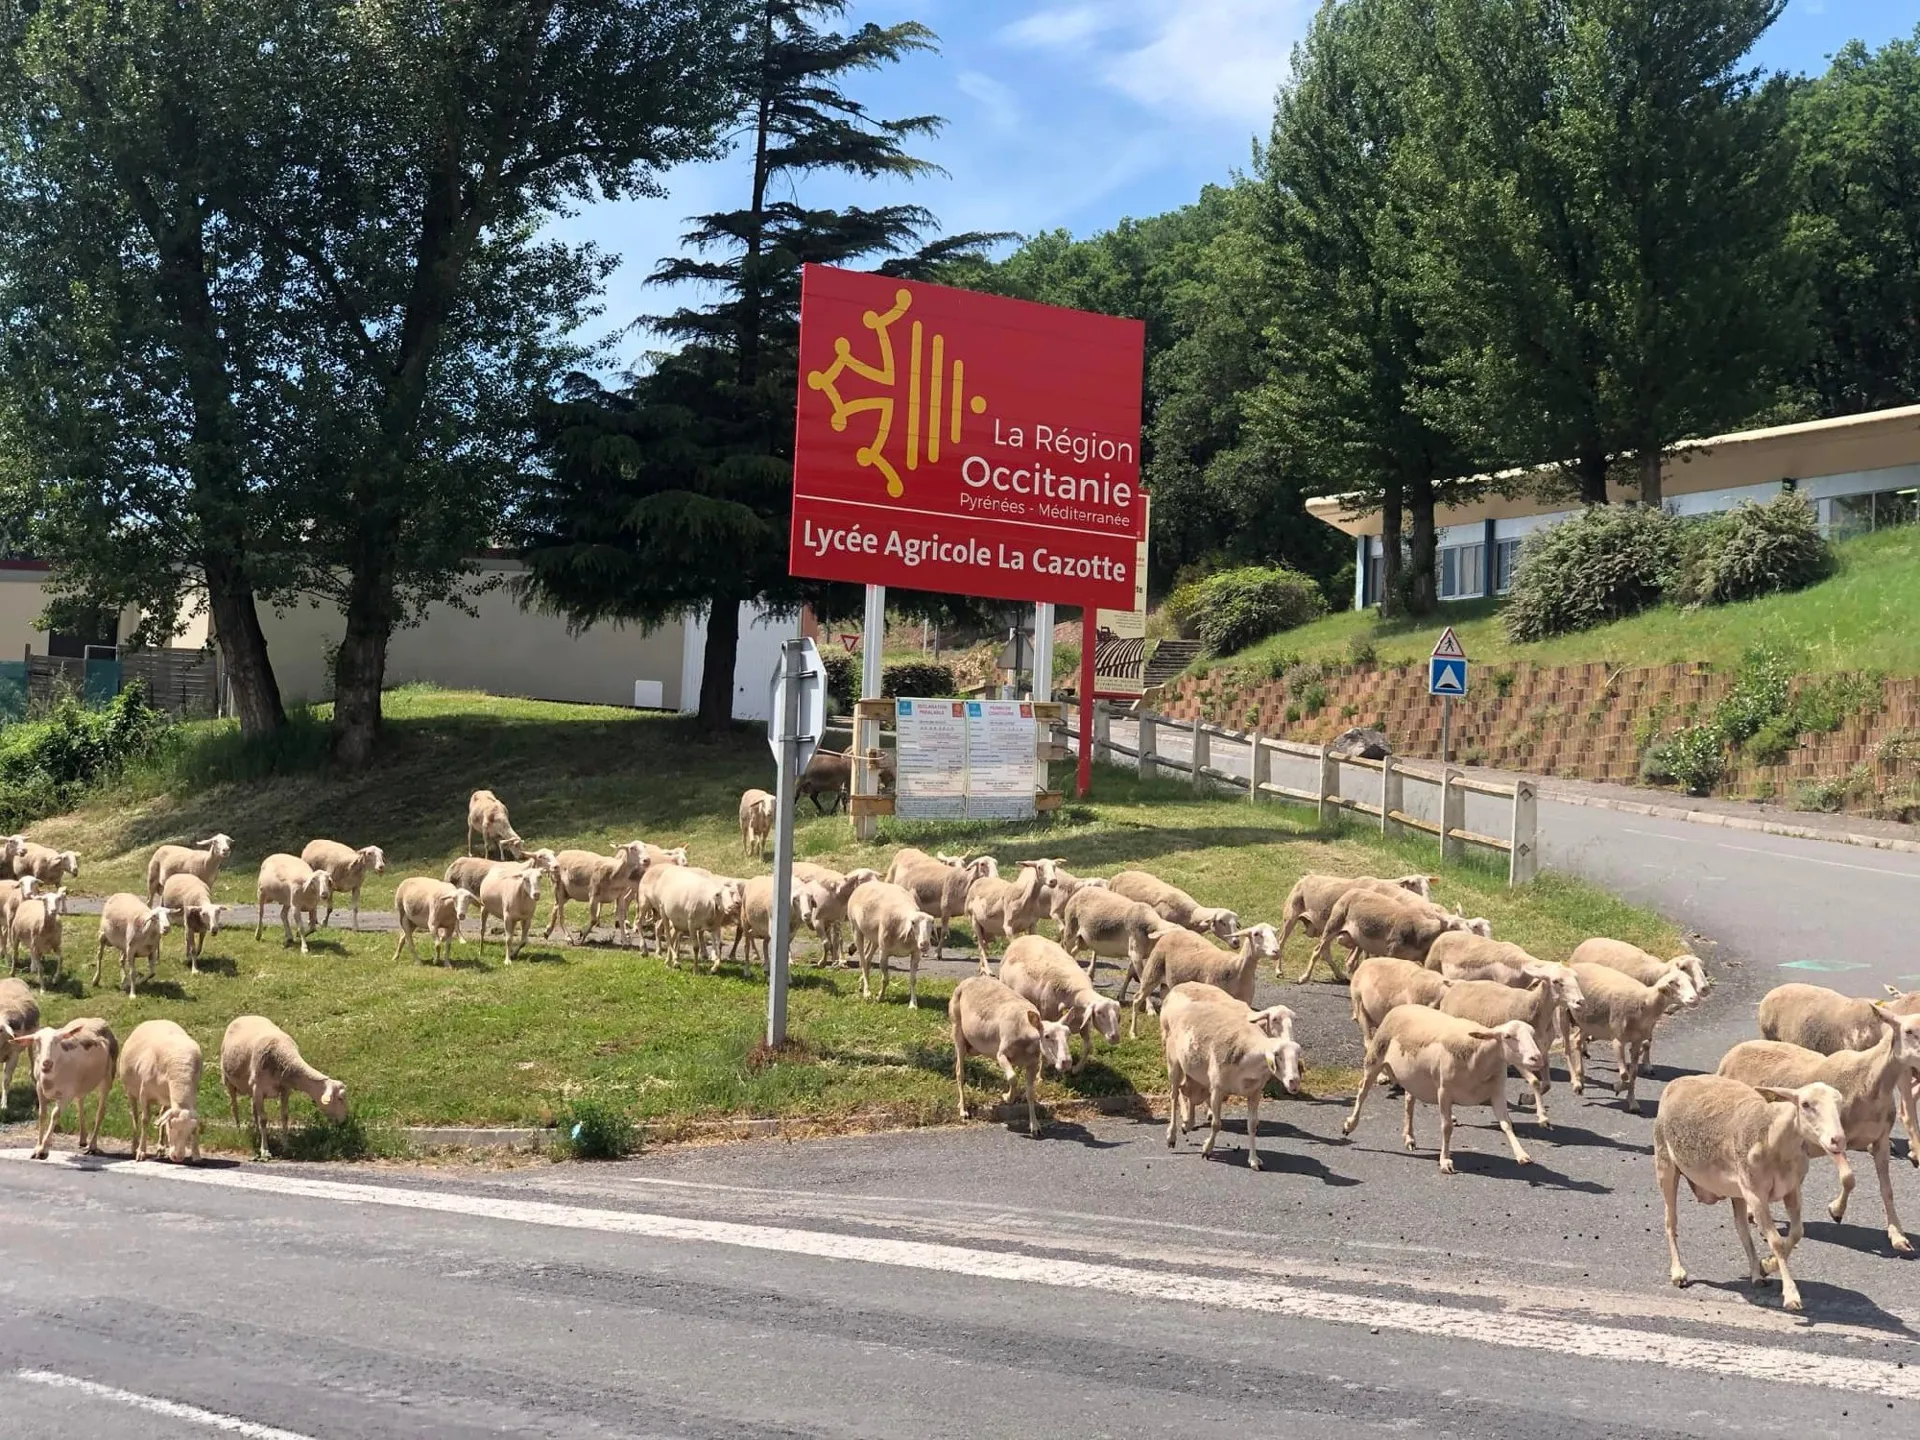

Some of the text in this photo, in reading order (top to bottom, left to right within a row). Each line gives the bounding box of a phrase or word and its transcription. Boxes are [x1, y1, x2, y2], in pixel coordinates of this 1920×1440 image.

[994, 418, 1133, 464] La Région
[961, 456, 1132, 508] Occitanie
[960, 492, 1026, 515] Pyrénées
[1038, 503, 1131, 528] Méditerranée
[804, 519, 1127, 583] Lycée Agricole La Cazotte
